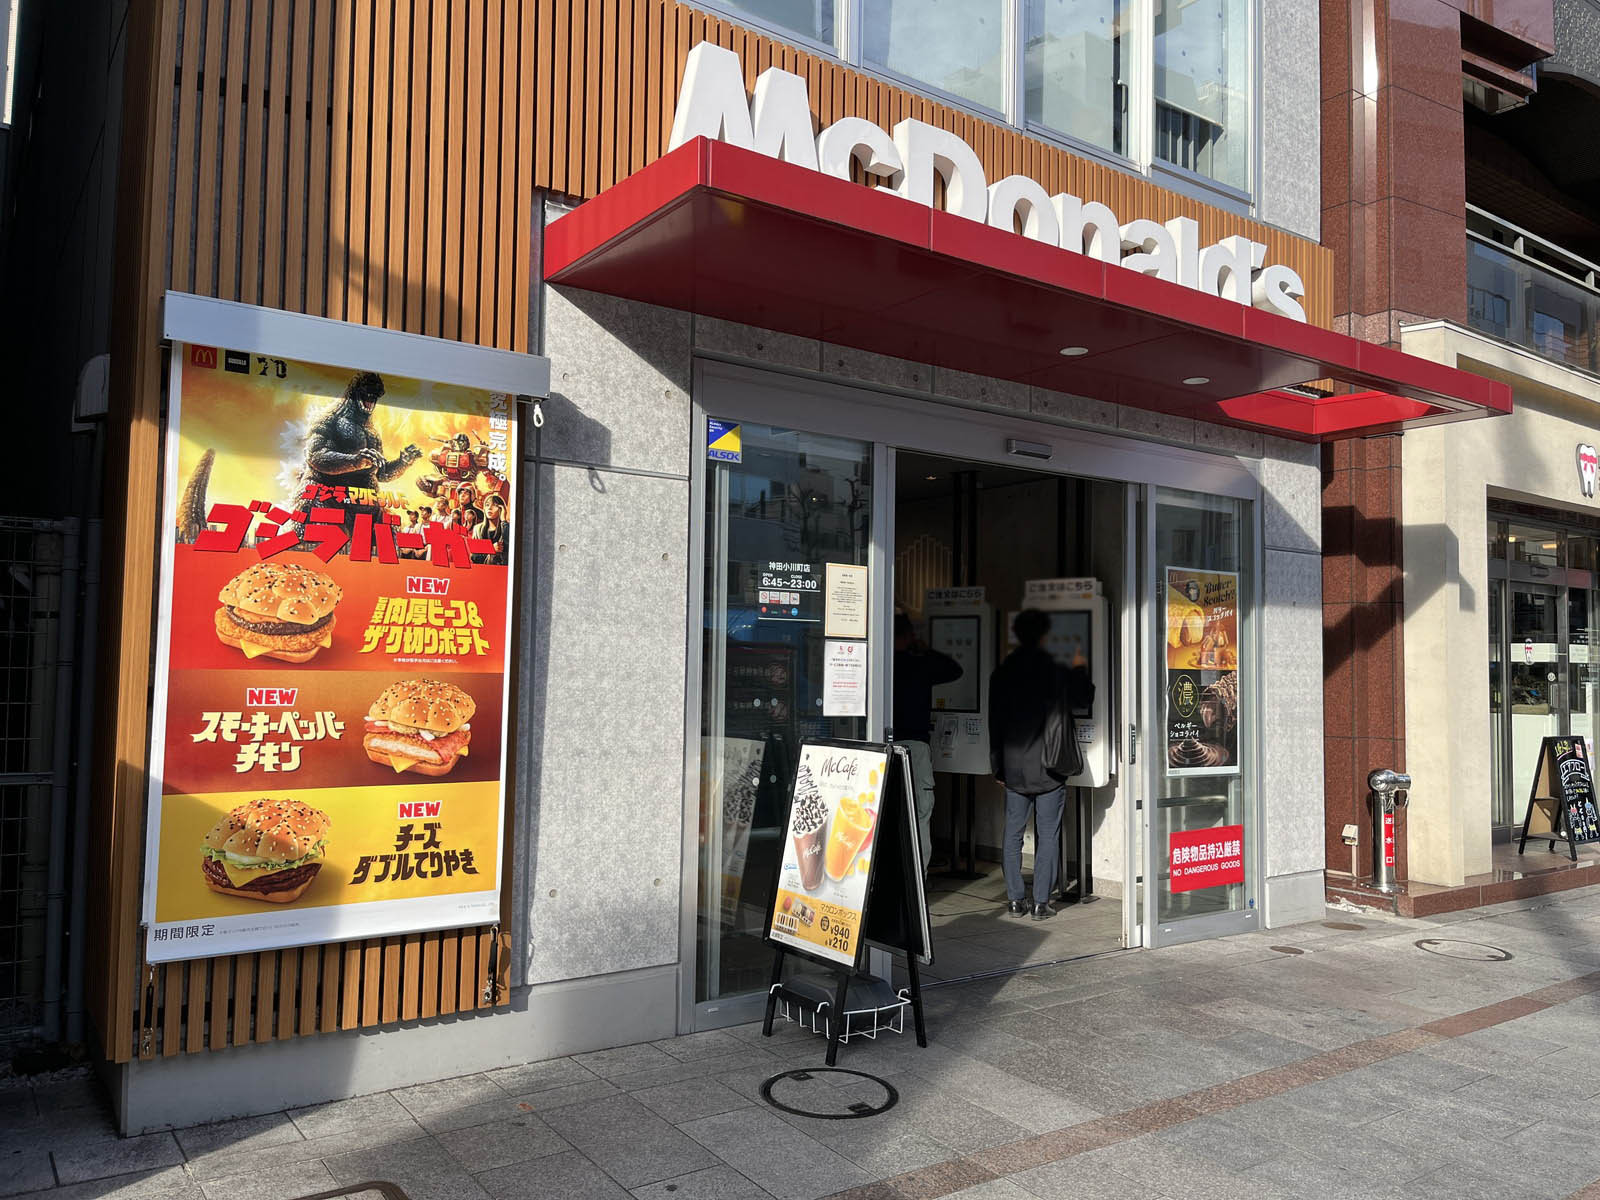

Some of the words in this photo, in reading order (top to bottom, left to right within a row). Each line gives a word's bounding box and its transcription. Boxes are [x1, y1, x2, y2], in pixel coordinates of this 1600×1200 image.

[666, 40, 1306, 323] McDonald's
[708, 449, 740, 461] ALSOK
[194, 500, 496, 568] ゴジラバーガー
[769, 561, 811, 573] 神田小川町店
[407, 577, 449, 594] NEW
[360, 626, 490, 656] ザク切りポテト
[247, 688, 298, 706] NEW
[1178, 681, 1194, 705] 濃
[189, 711, 345, 742] スモーキーペッパー
[1169, 730, 1200, 738] ショコラパイ
[1174, 722, 1198, 730] ベルギー
[232, 742, 304, 773] チキン
[820, 756, 858, 781] McCafé
[398, 801, 441, 818] NEW
[394, 823, 442, 852] チーズ
[1172, 840, 1241, 865] 危険物品持込厳禁
[349, 849, 480, 885] ダブルてりやき
[1172, 868, 1182, 877] NO
[1183, 863, 1219, 876] DANGEROUS
[1220, 860, 1241, 870] GOODS
[820, 903, 857, 921] マカロンボックス
[153, 924, 216, 941] 期間限定
[830, 925, 850, 940] ¥940
